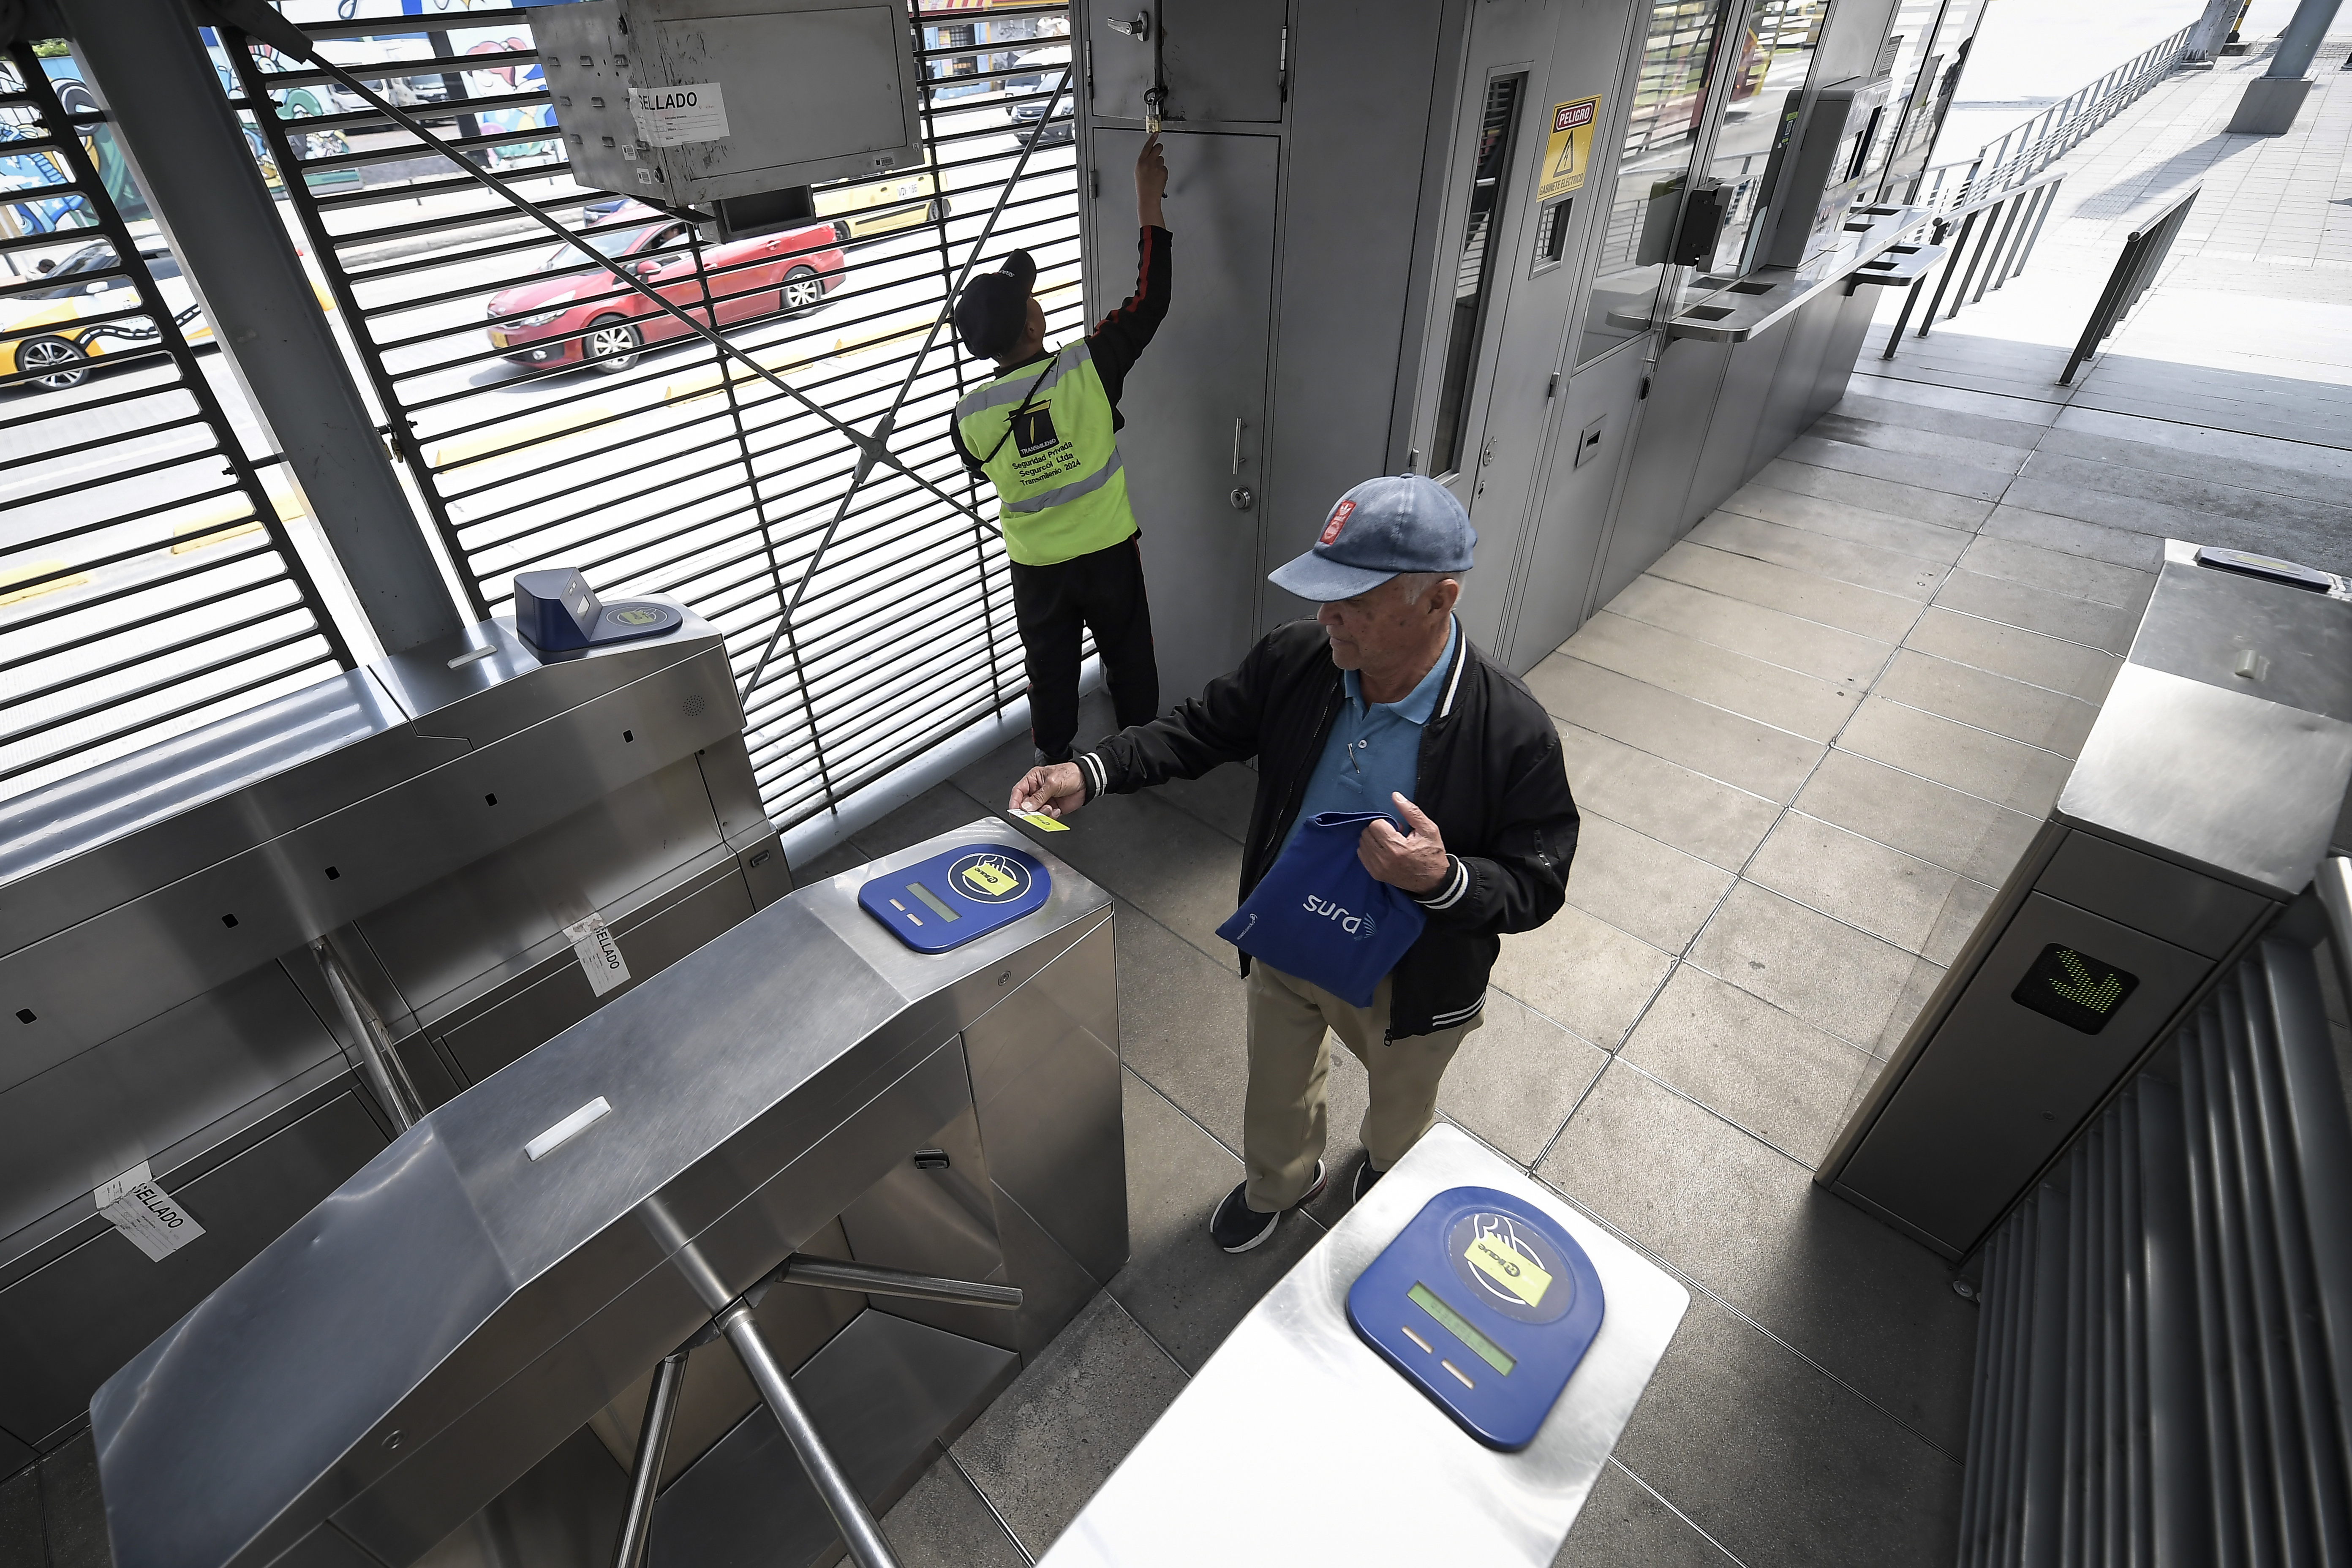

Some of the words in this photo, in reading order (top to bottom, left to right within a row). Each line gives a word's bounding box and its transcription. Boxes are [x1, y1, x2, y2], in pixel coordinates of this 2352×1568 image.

[638, 92, 697, 111] SELLADO
[1559, 107, 1590, 126] PELIGRO
[1539, 180, 1561, 195] GABINETE
[1560, 173, 1583, 188] ELÉCTRICO
[1012, 454, 1046, 470] Seguridad
[1048, 441, 1073, 458] Privada
[1020, 438, 1056, 455] TRANSMILENIO
[1019, 461, 1053, 477] Segurcol
[1056, 453, 1074, 463] Ltda
[1019, 468, 1062, 486] Transmilenio
[1064, 459, 1081, 471] 2024
[1302, 895, 1362, 934] sura
[594, 927, 620, 969] SELLADO
[131, 1182, 184, 1228] SELLADO
